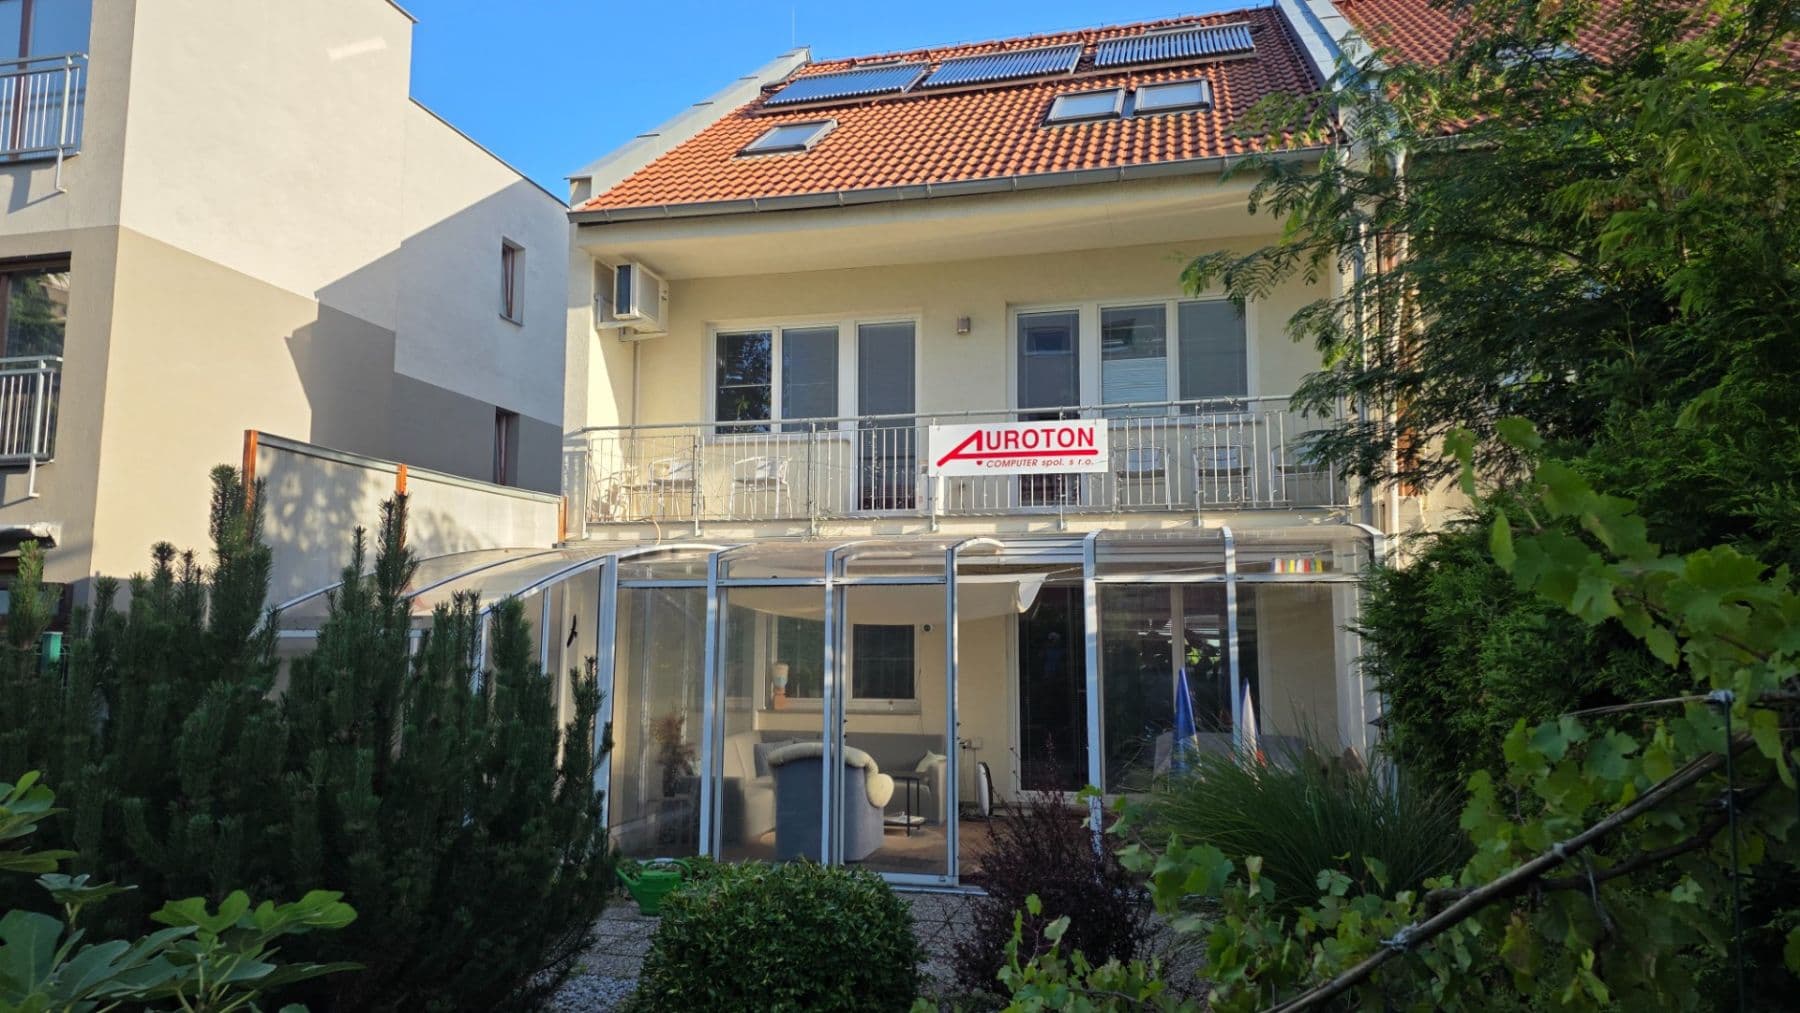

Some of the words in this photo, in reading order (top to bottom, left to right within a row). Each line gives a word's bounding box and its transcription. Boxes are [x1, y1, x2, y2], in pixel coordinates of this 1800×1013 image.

[936, 427, 1099, 467] AUROTON
[986, 458, 1038, 469] COMPUTER
[1041, 458, 1064, 467] spol.
